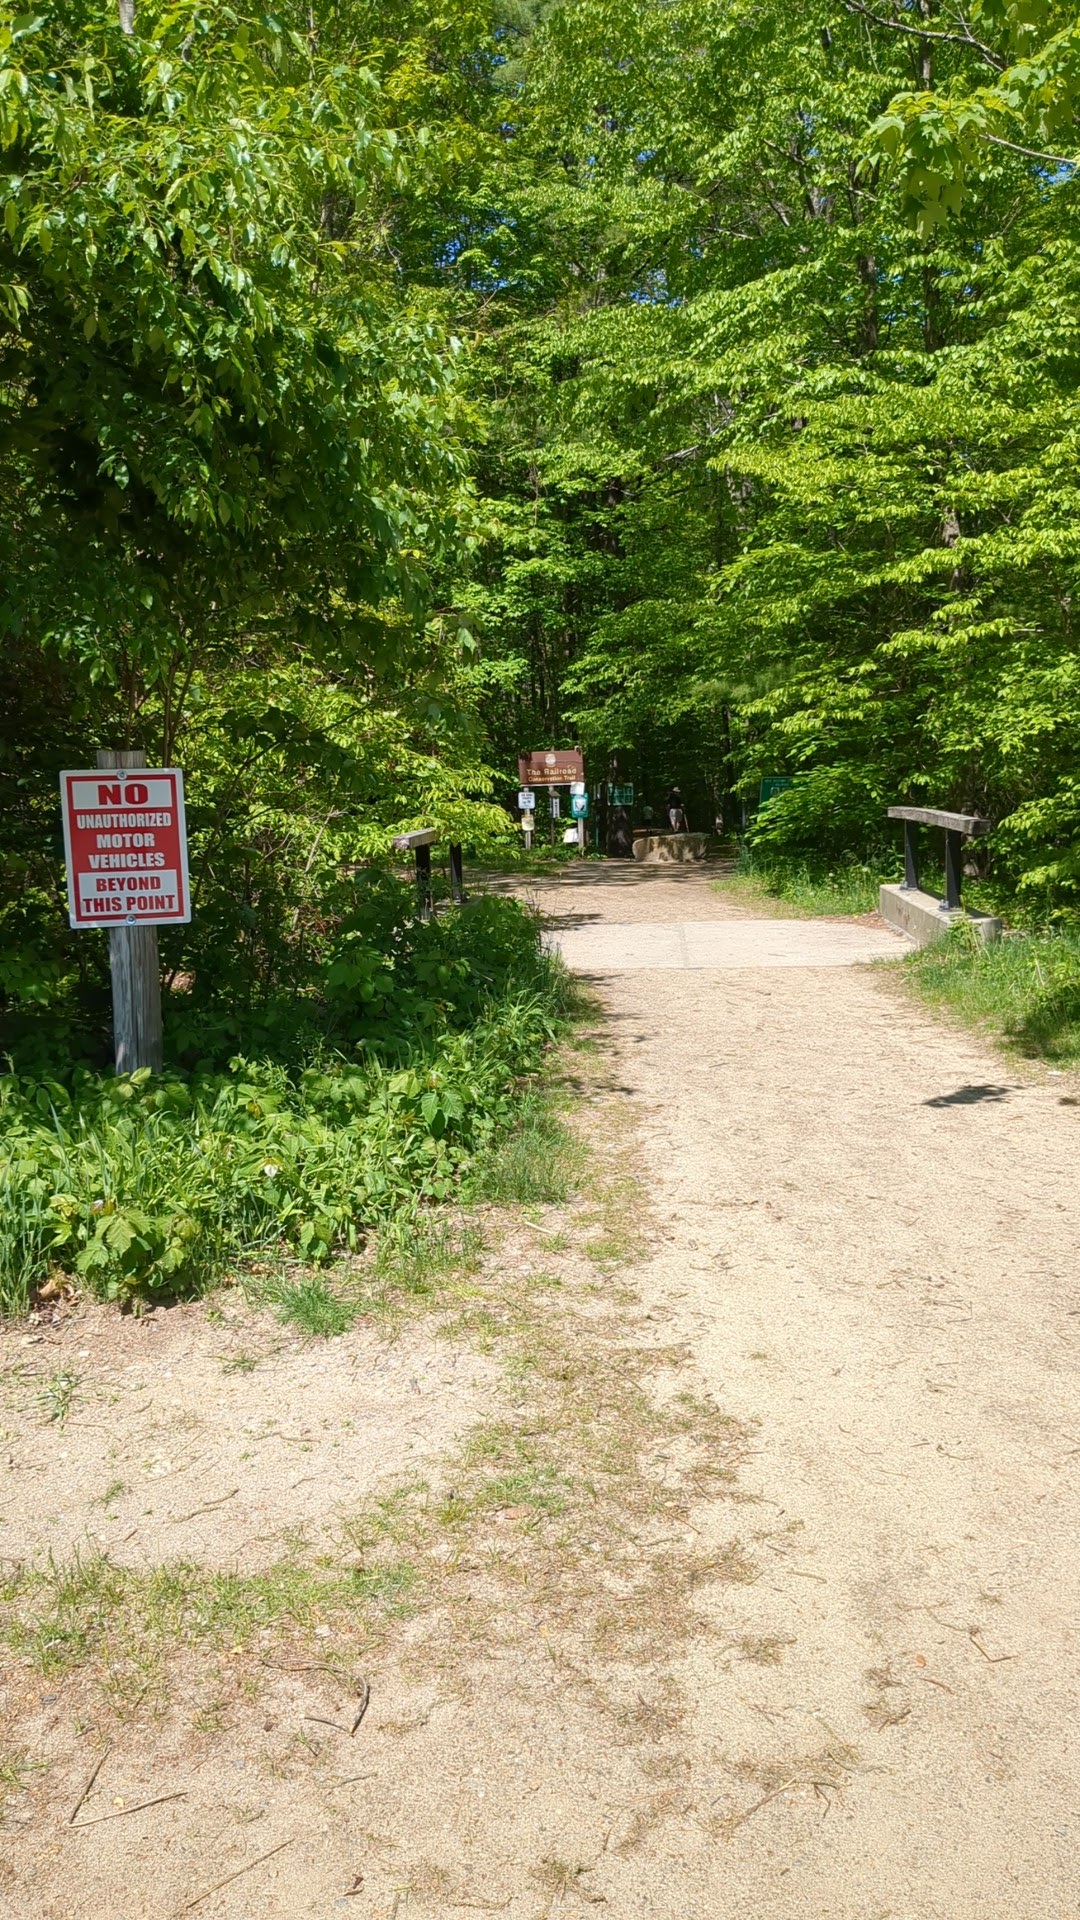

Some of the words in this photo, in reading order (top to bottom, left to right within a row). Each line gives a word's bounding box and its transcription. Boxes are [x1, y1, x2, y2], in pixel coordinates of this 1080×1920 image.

[97, 783, 149, 806] NO
[76, 812, 171, 829] UNAUTHORIZED
[96, 833, 155, 849] MOTOR
[88, 852, 165, 869] VEHICLES
[96, 876, 161, 892] BEYOND
[82, 898, 122, 912] THIS
[126, 895, 175, 911] POINT
